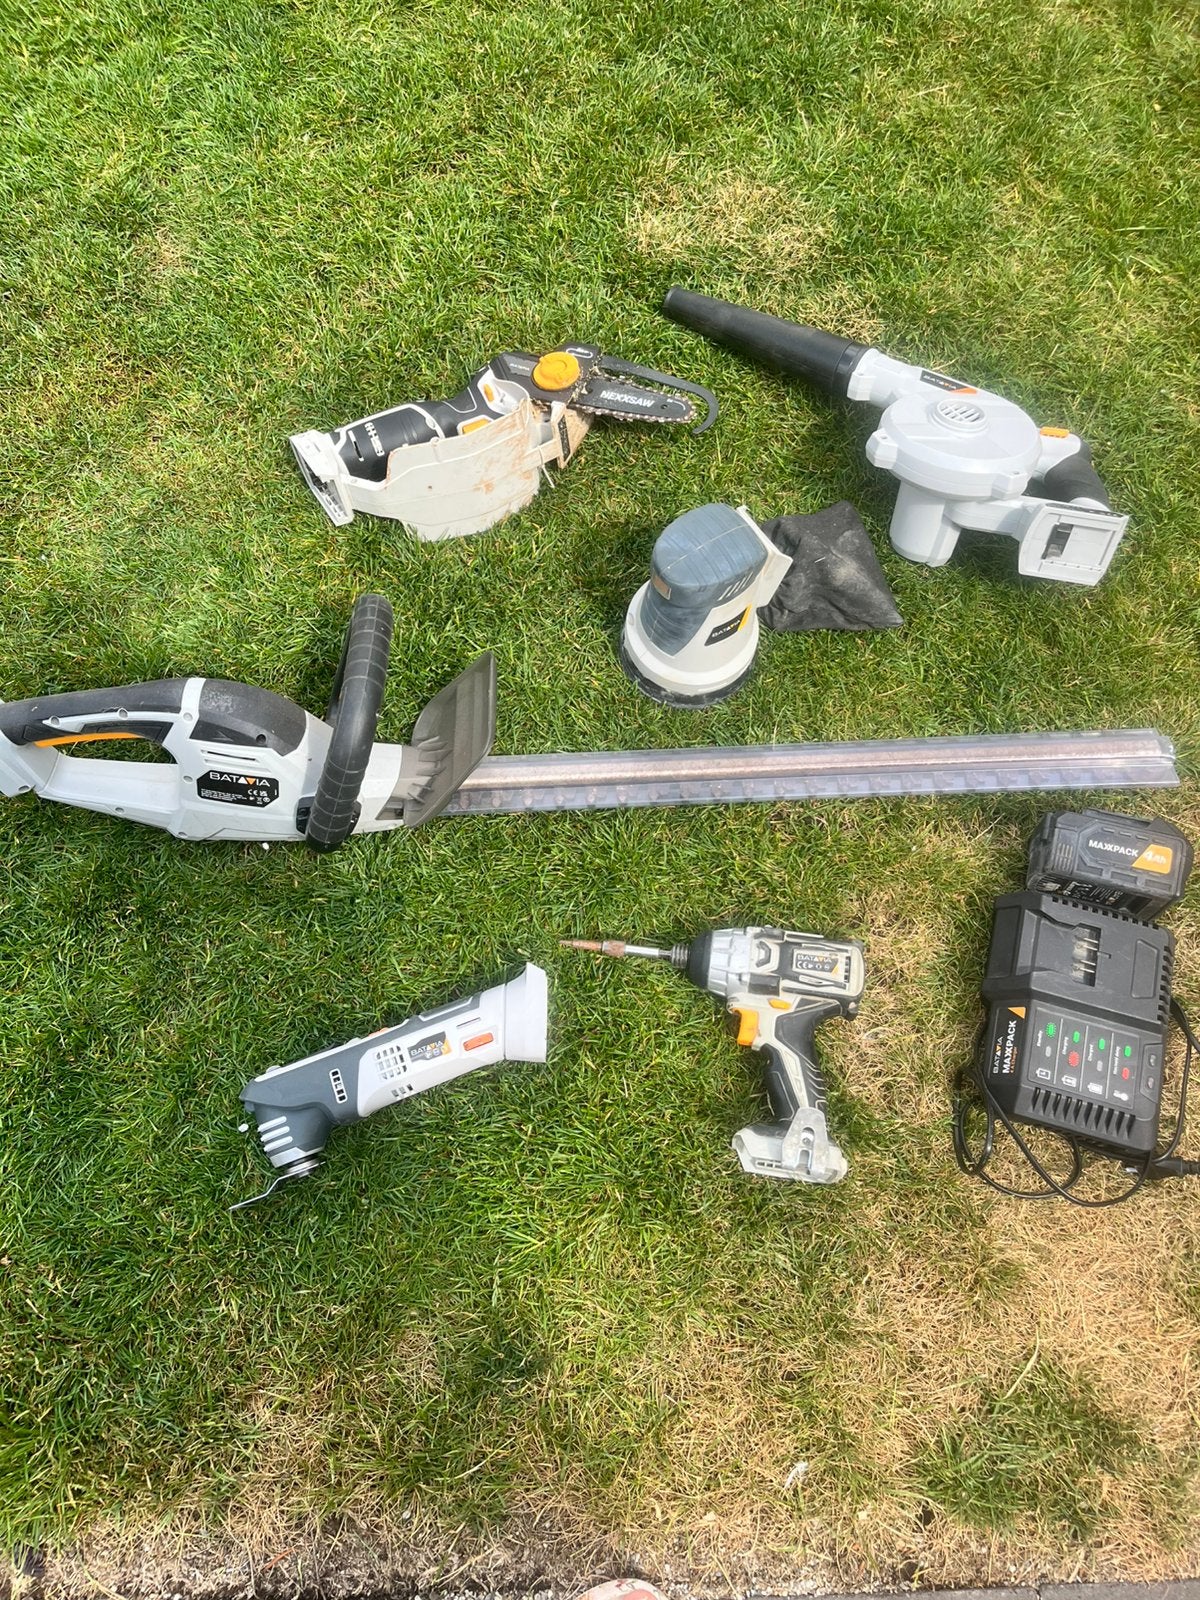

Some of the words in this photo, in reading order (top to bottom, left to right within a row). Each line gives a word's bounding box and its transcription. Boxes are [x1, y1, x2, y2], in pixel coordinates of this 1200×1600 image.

[600, 390, 655, 408] NEXXSAW
[209, 771, 271, 787] BATAVIA
[1088, 839, 1140, 857] MAXXPACK
[410, 1040, 444, 1056] BATAVIA
[992, 1036, 1004, 1074] BATAVIA
[1002, 1020, 1017, 1074] MAXXPACK
